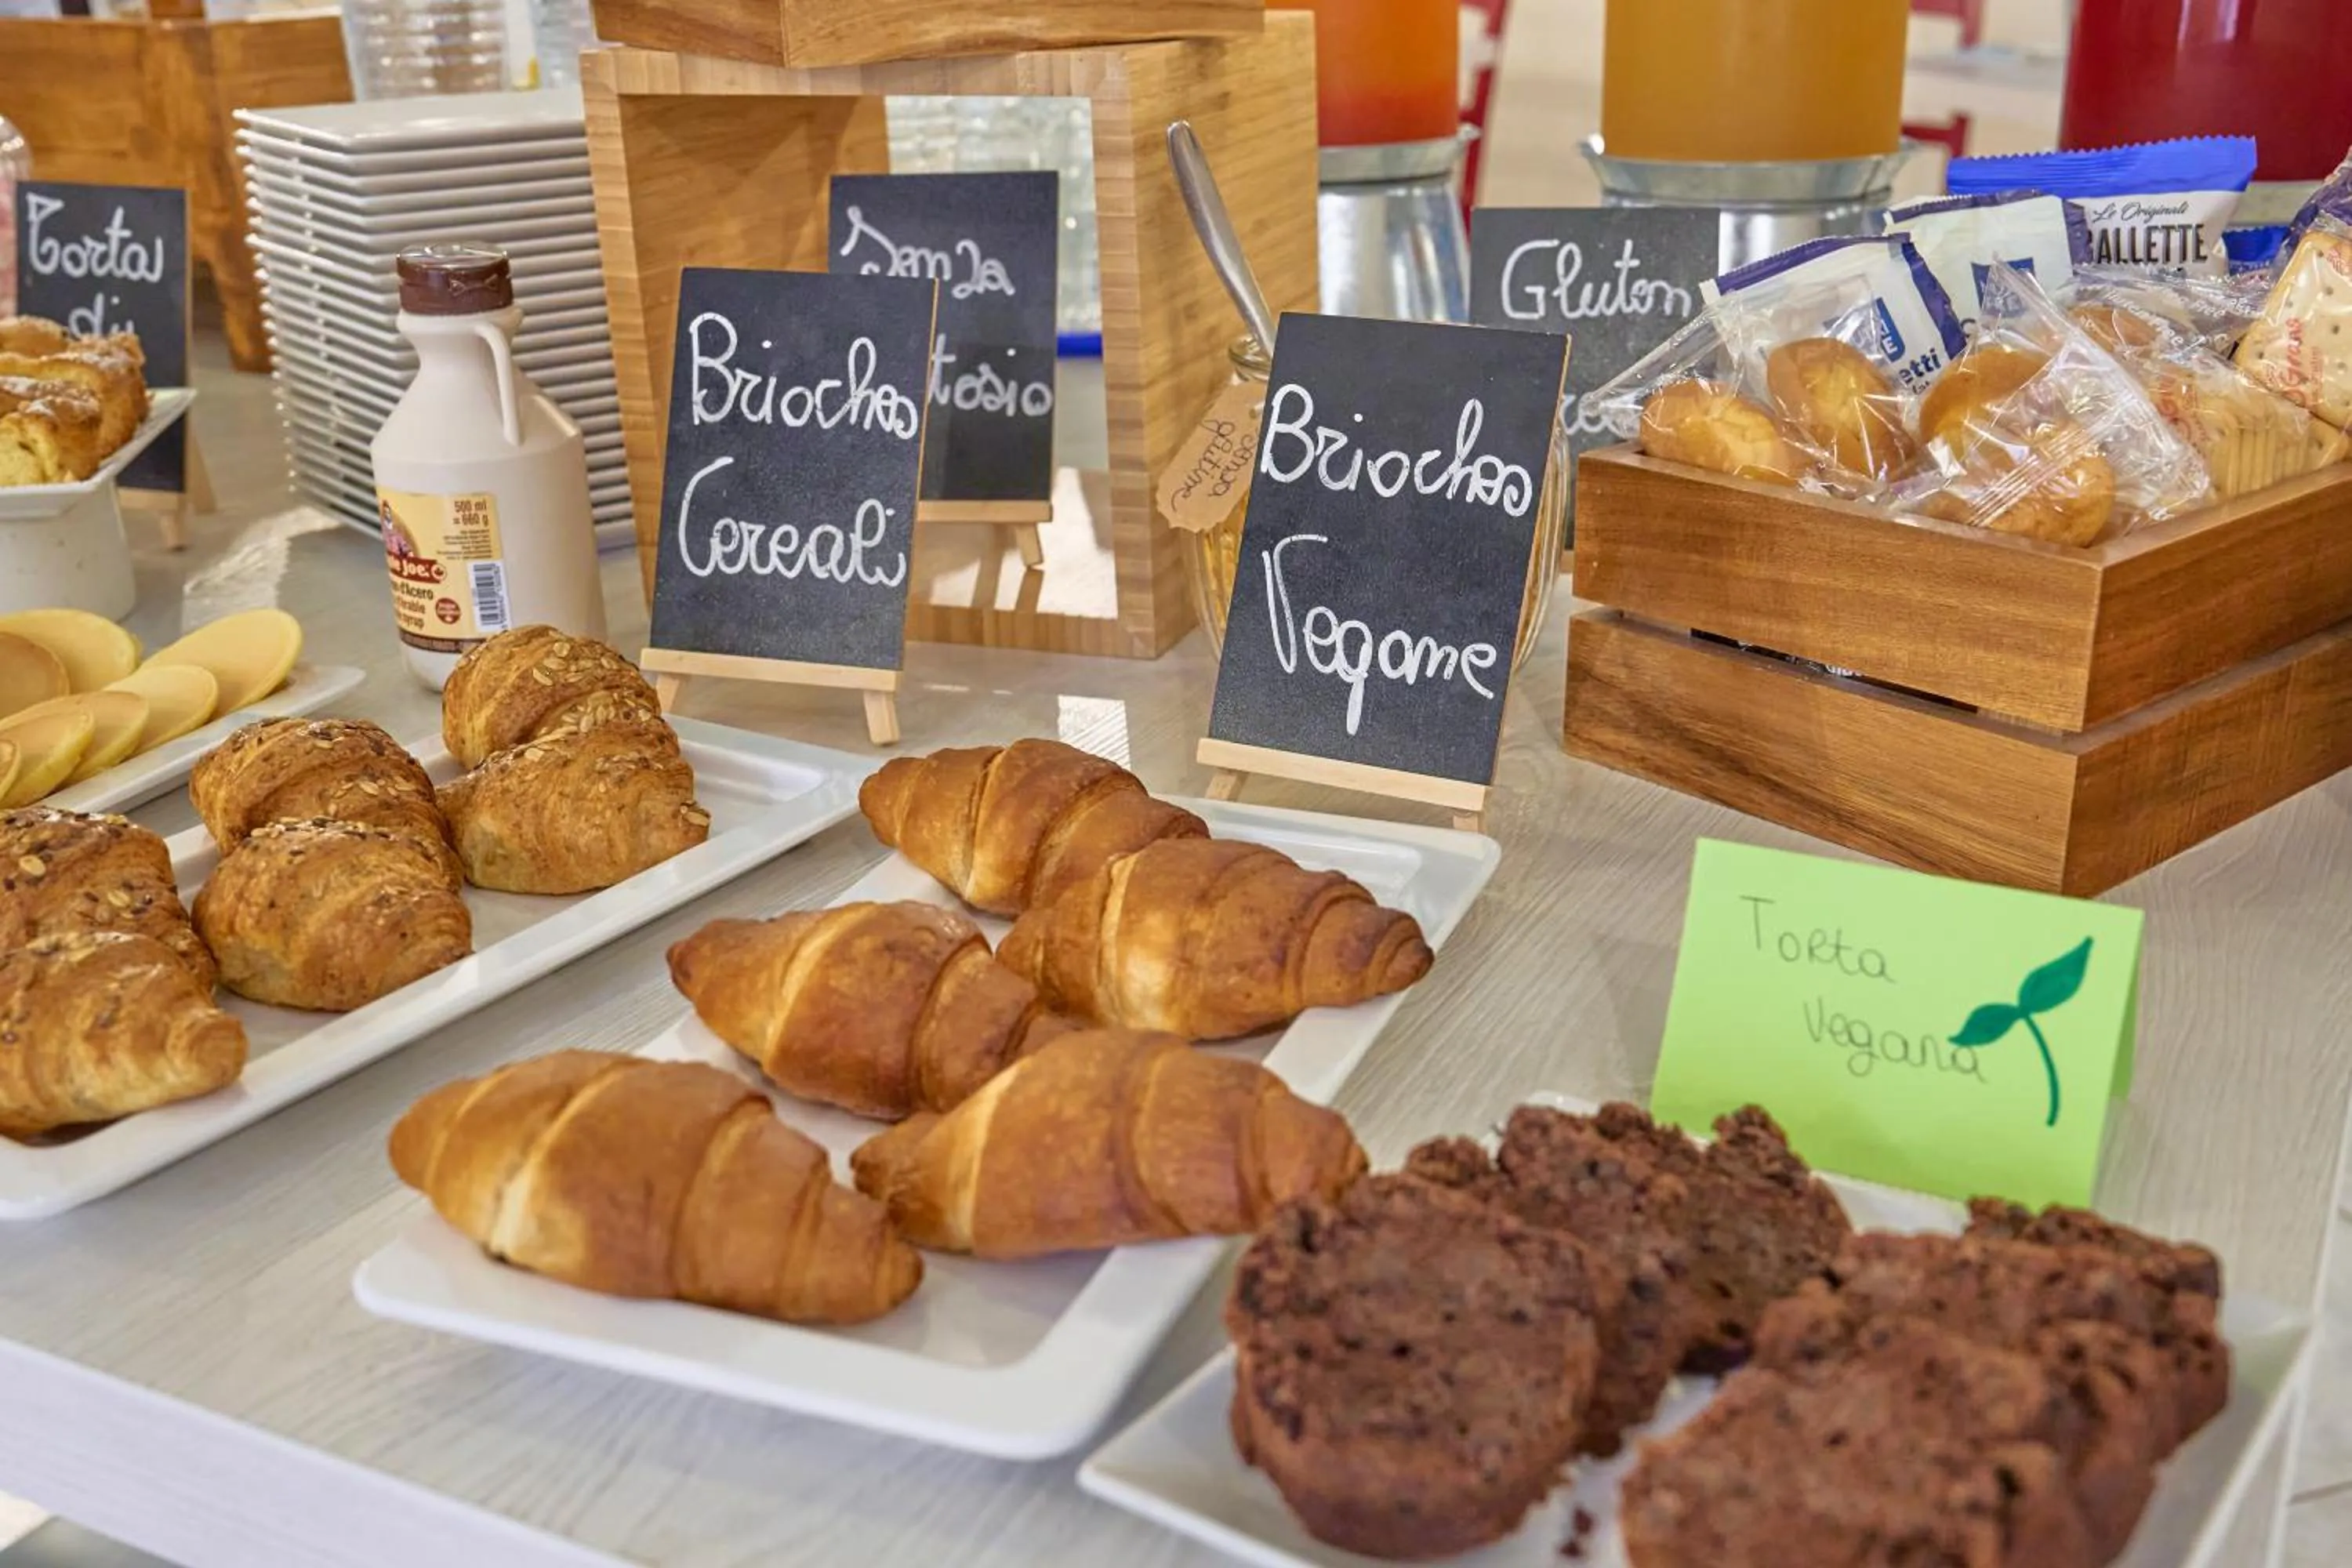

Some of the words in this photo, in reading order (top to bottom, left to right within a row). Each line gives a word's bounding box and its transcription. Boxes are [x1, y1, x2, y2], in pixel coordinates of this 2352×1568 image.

[25, 192, 164, 283] Torta
[1501, 238, 1692, 320] Gluten
[927, 332, 1053, 417] tosio
[679, 456, 907, 587] Cereali
[1261, 534, 1497, 736] Vegane
[1803, 996, 1990, 1084] Vegana
